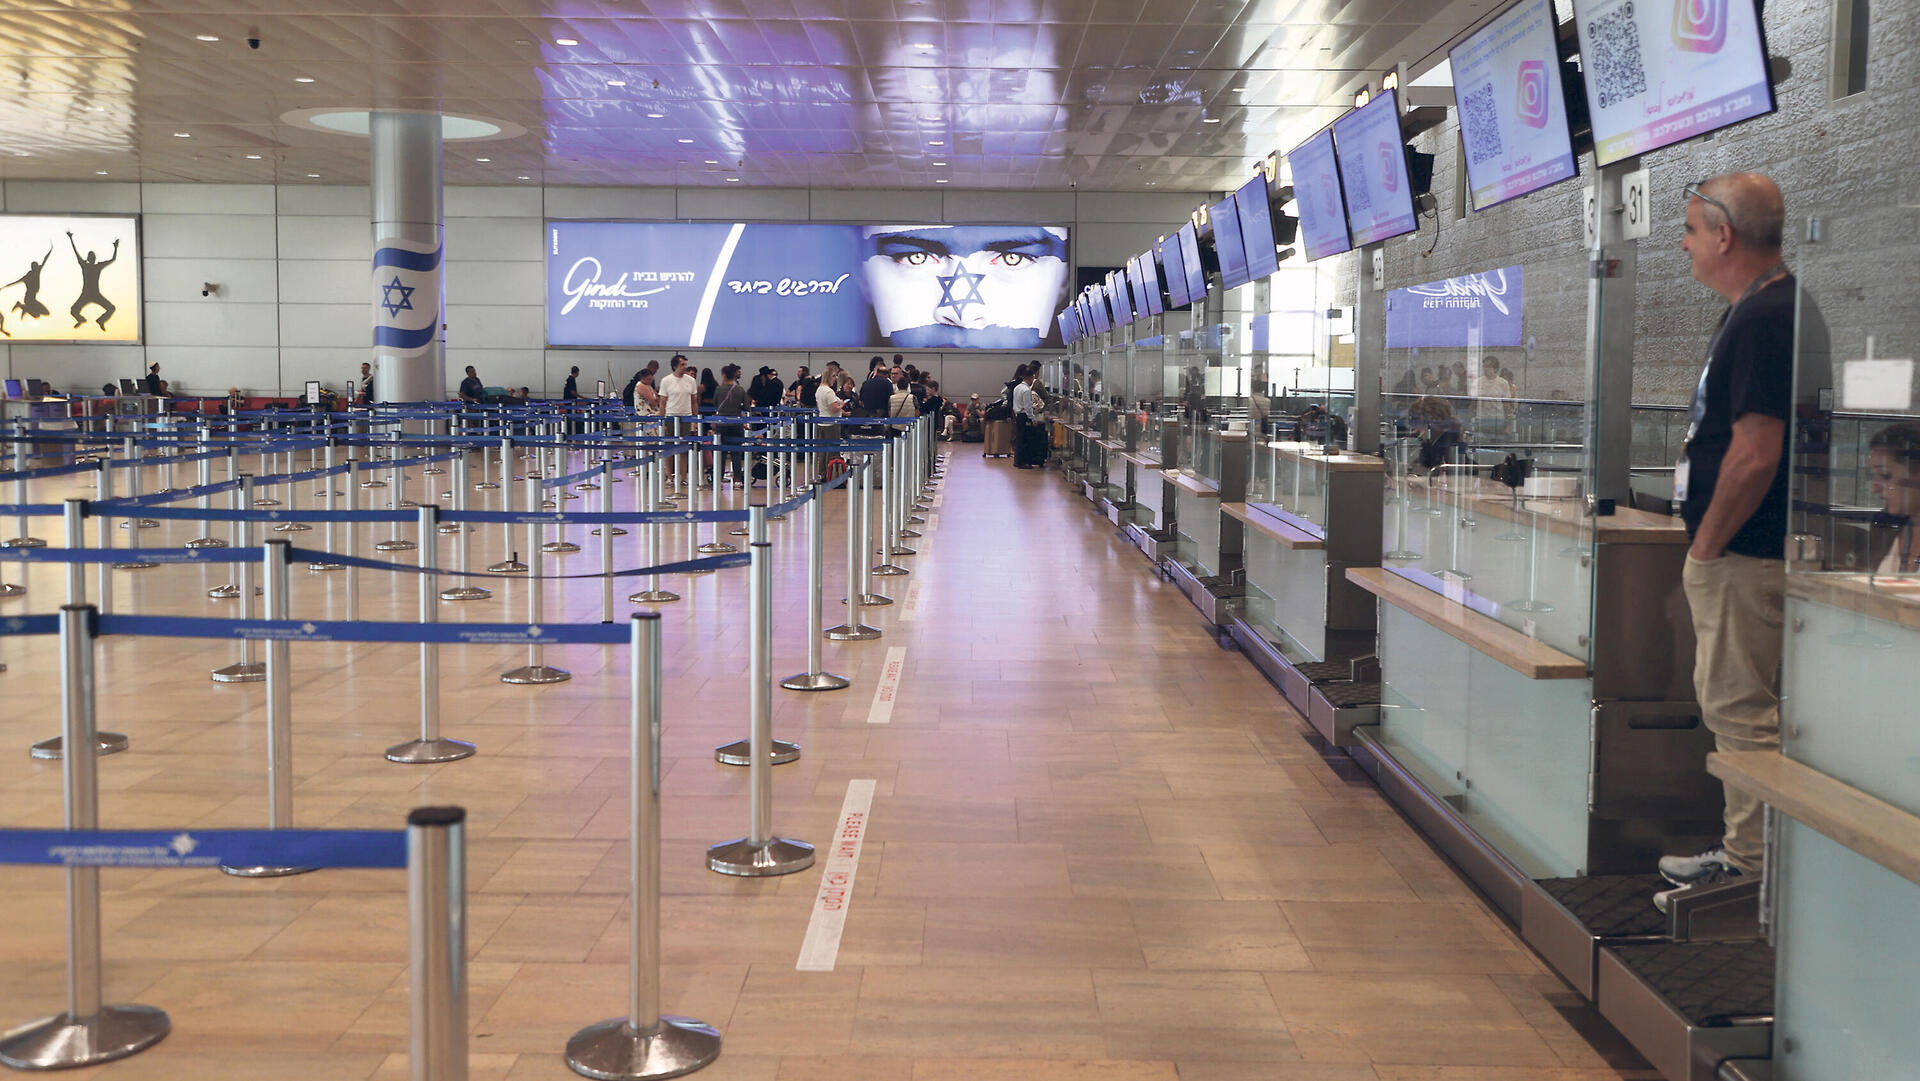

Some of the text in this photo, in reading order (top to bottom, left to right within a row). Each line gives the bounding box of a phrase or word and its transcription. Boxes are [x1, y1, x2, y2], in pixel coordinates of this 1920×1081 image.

[1629, 183, 1643, 225] 31
[727, 273, 850, 297] להרגיש ביחד
[837, 812, 864, 858] PLEASE WAIT
